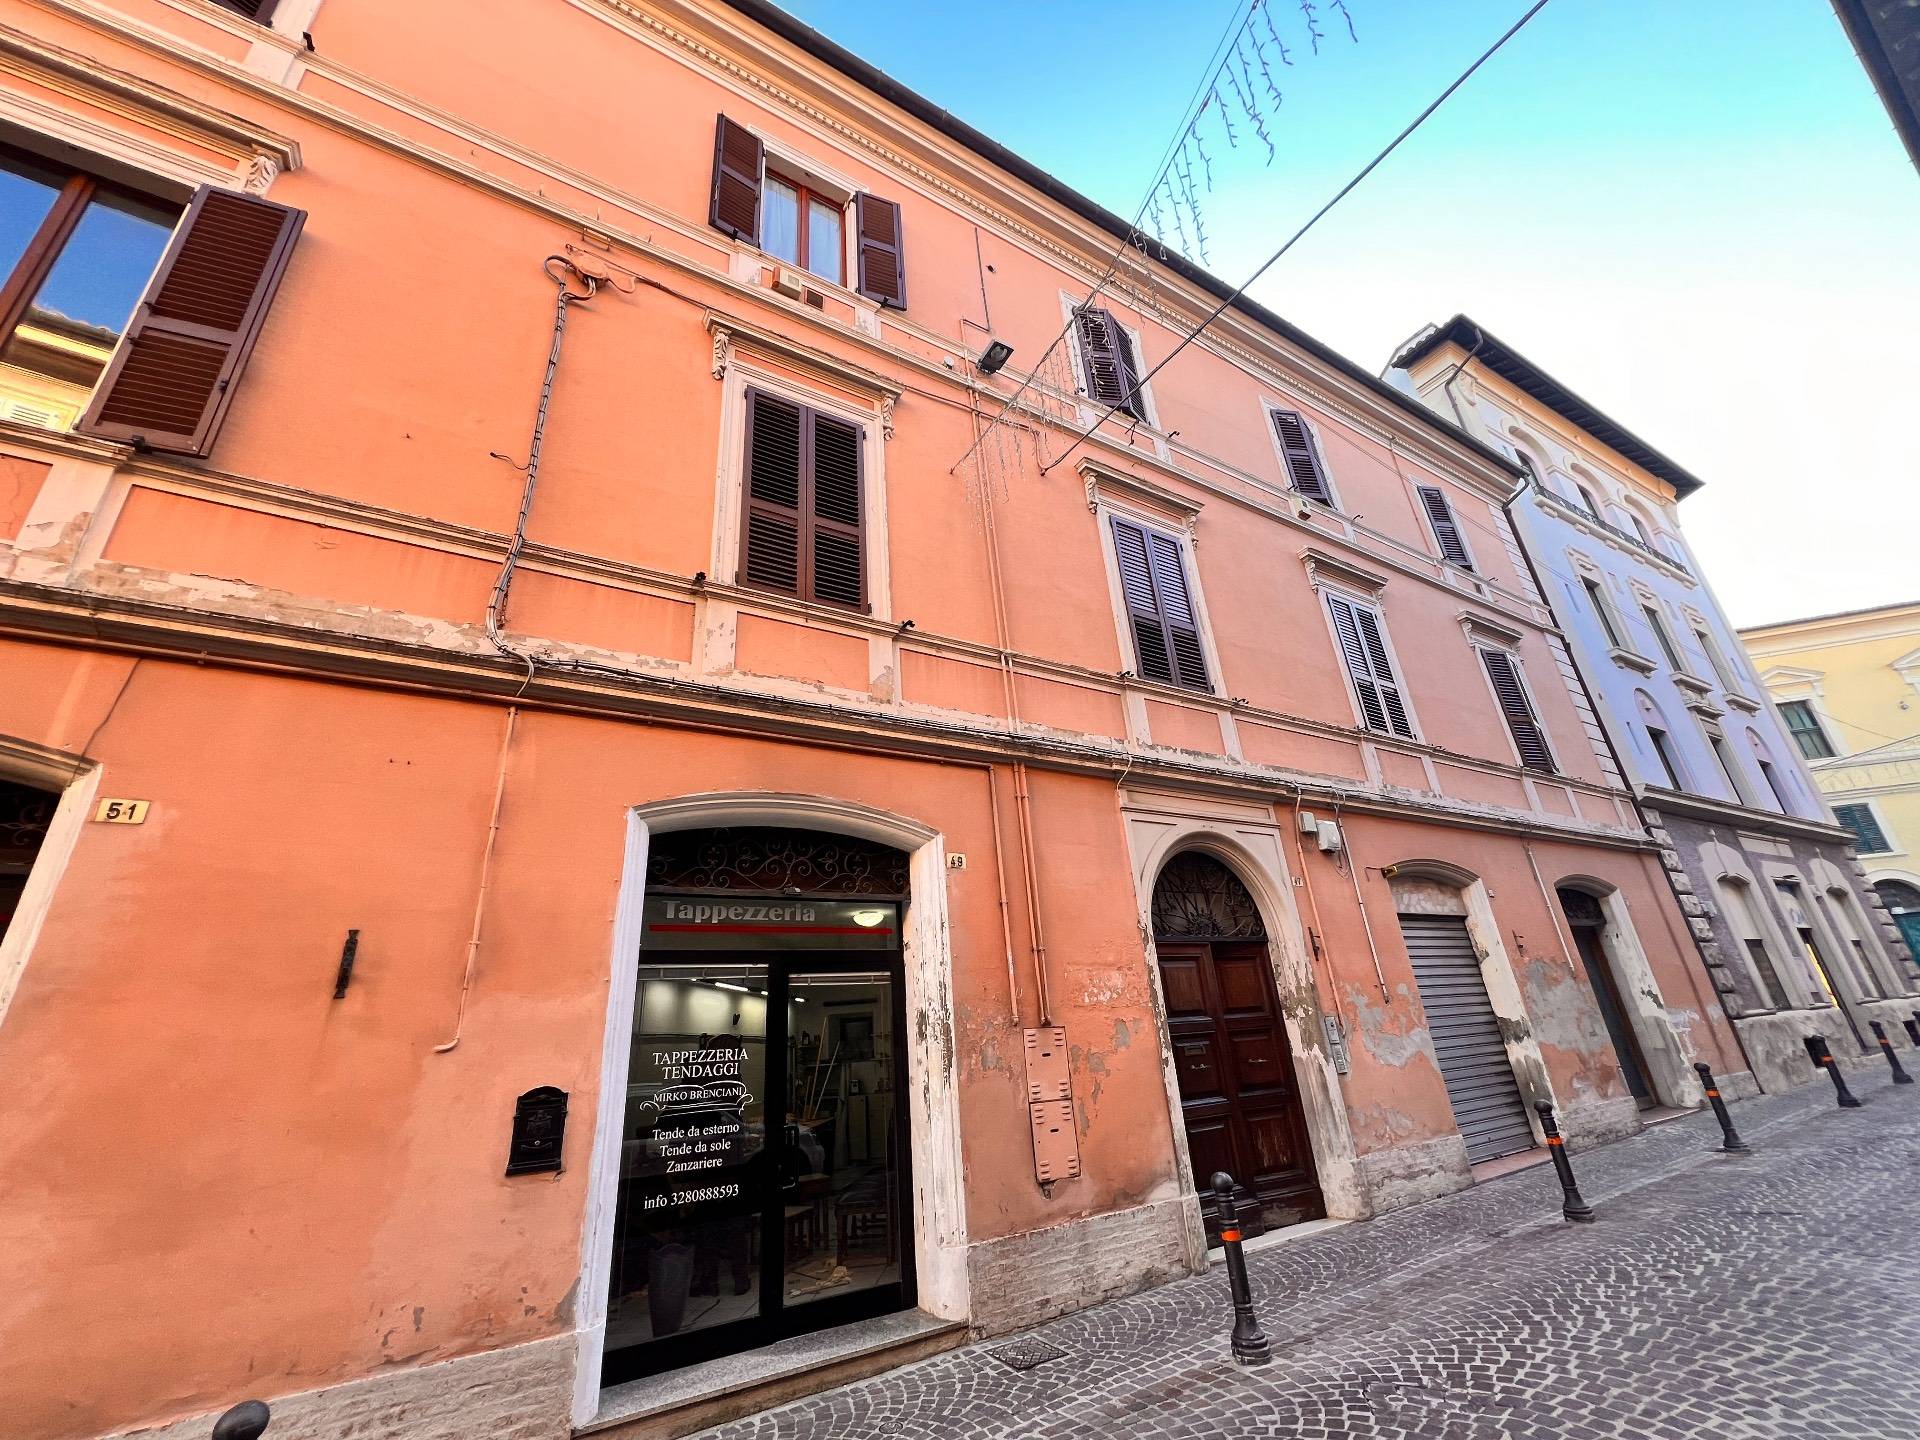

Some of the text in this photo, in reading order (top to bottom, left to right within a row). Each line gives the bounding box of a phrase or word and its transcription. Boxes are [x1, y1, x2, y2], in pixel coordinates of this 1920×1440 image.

[106, 802, 137, 820] 51
[950, 855, 963, 867] 49
[661, 900, 816, 924] Tappezzeria
[652, 1048, 749, 1065] TAPPEZZERIA
[661, 1062, 739, 1080] TENDAGGI
[653, 1086, 742, 1103] MIRKO BRENCIANI
[652, 1123, 740, 1141] Tende da esterno
[660, 1138, 732, 1157] Tende da sole
[665, 1156, 723, 1174] Zanzariere
[643, 1183, 739, 1210] info 3280888593
